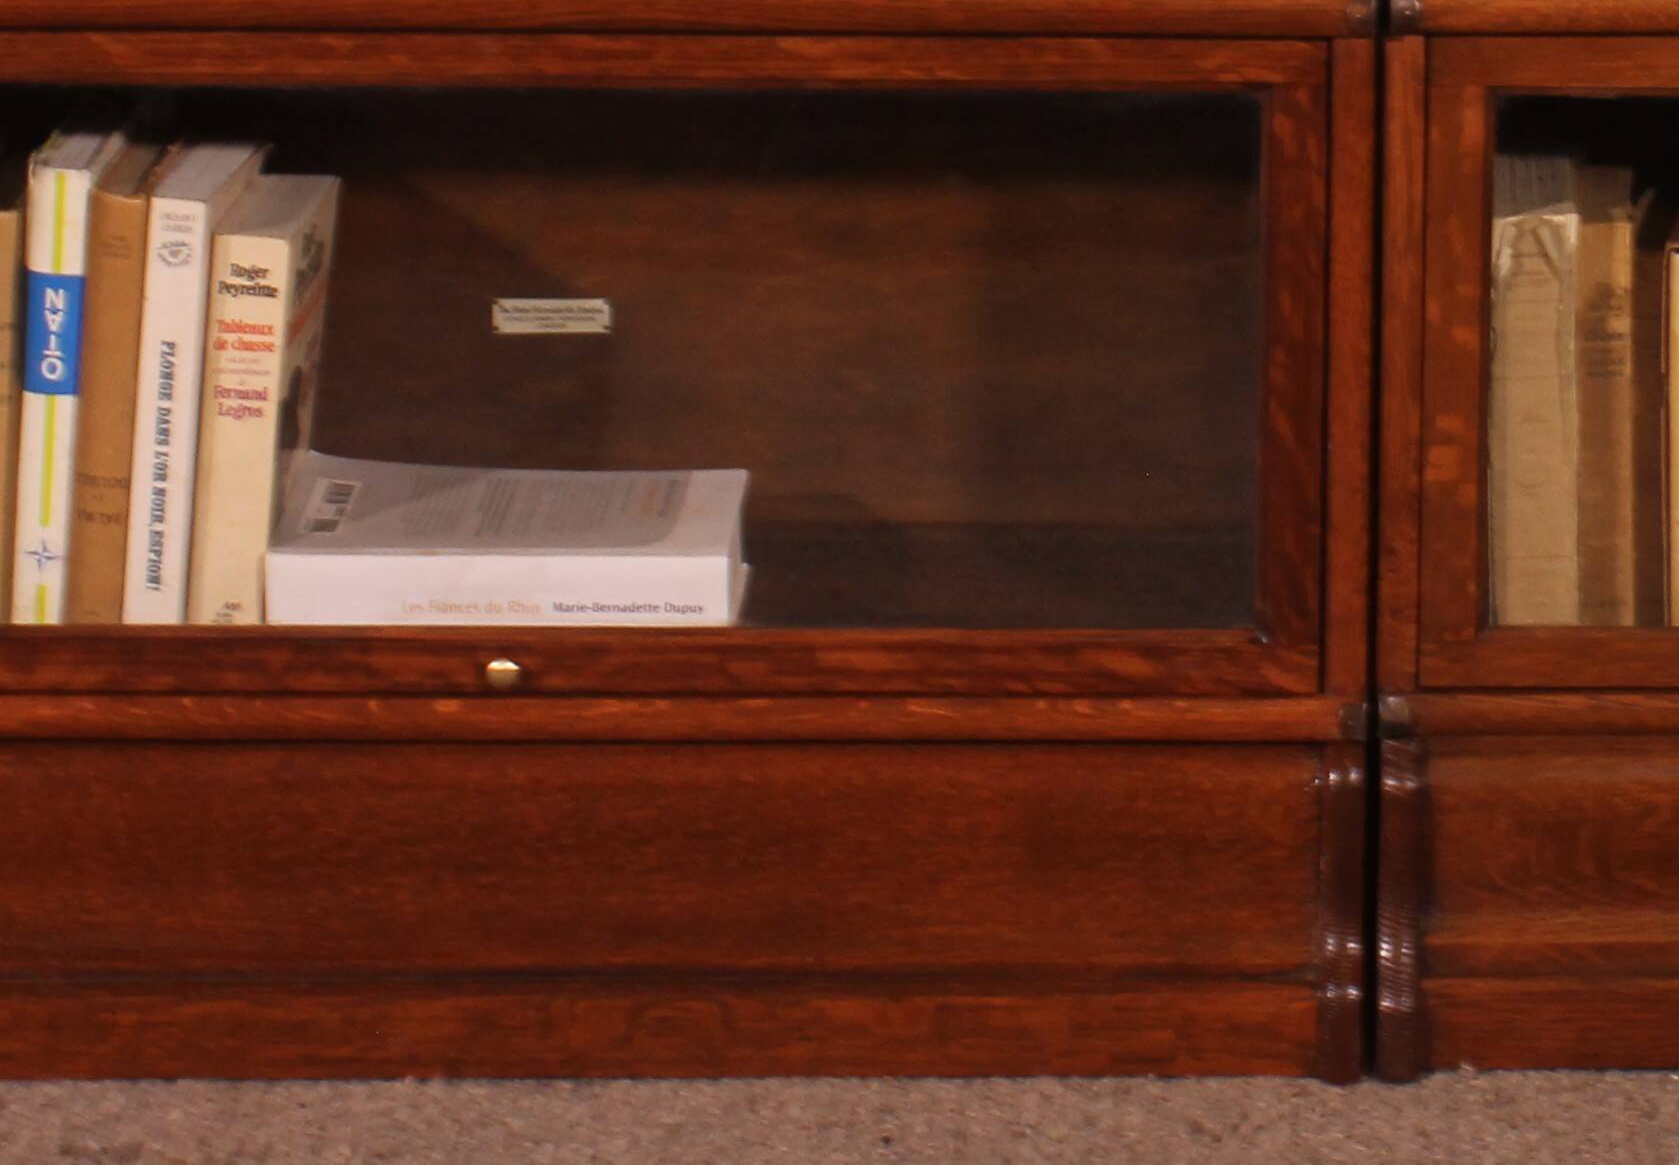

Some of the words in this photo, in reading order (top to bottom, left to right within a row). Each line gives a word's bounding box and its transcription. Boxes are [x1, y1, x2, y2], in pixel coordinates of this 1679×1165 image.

[229, 262, 270, 282] Roger
[217, 281, 279, 298] Peyrefitte
[215, 319, 275, 336] Tableaux
[213, 336, 230, 352] de
[230, 337, 276, 353] chasse
[158, 339, 176, 401] PLONGE
[213, 384, 269, 402] Fernand
[217, 402, 264, 419] Legros
[155, 406, 173, 446] DANS
[152, 450, 171, 482] L'OR
[484, 600, 504, 614] du
[552, 601, 661, 614] Marie-Bernadette
[664, 602, 705, 616] Dupuy
